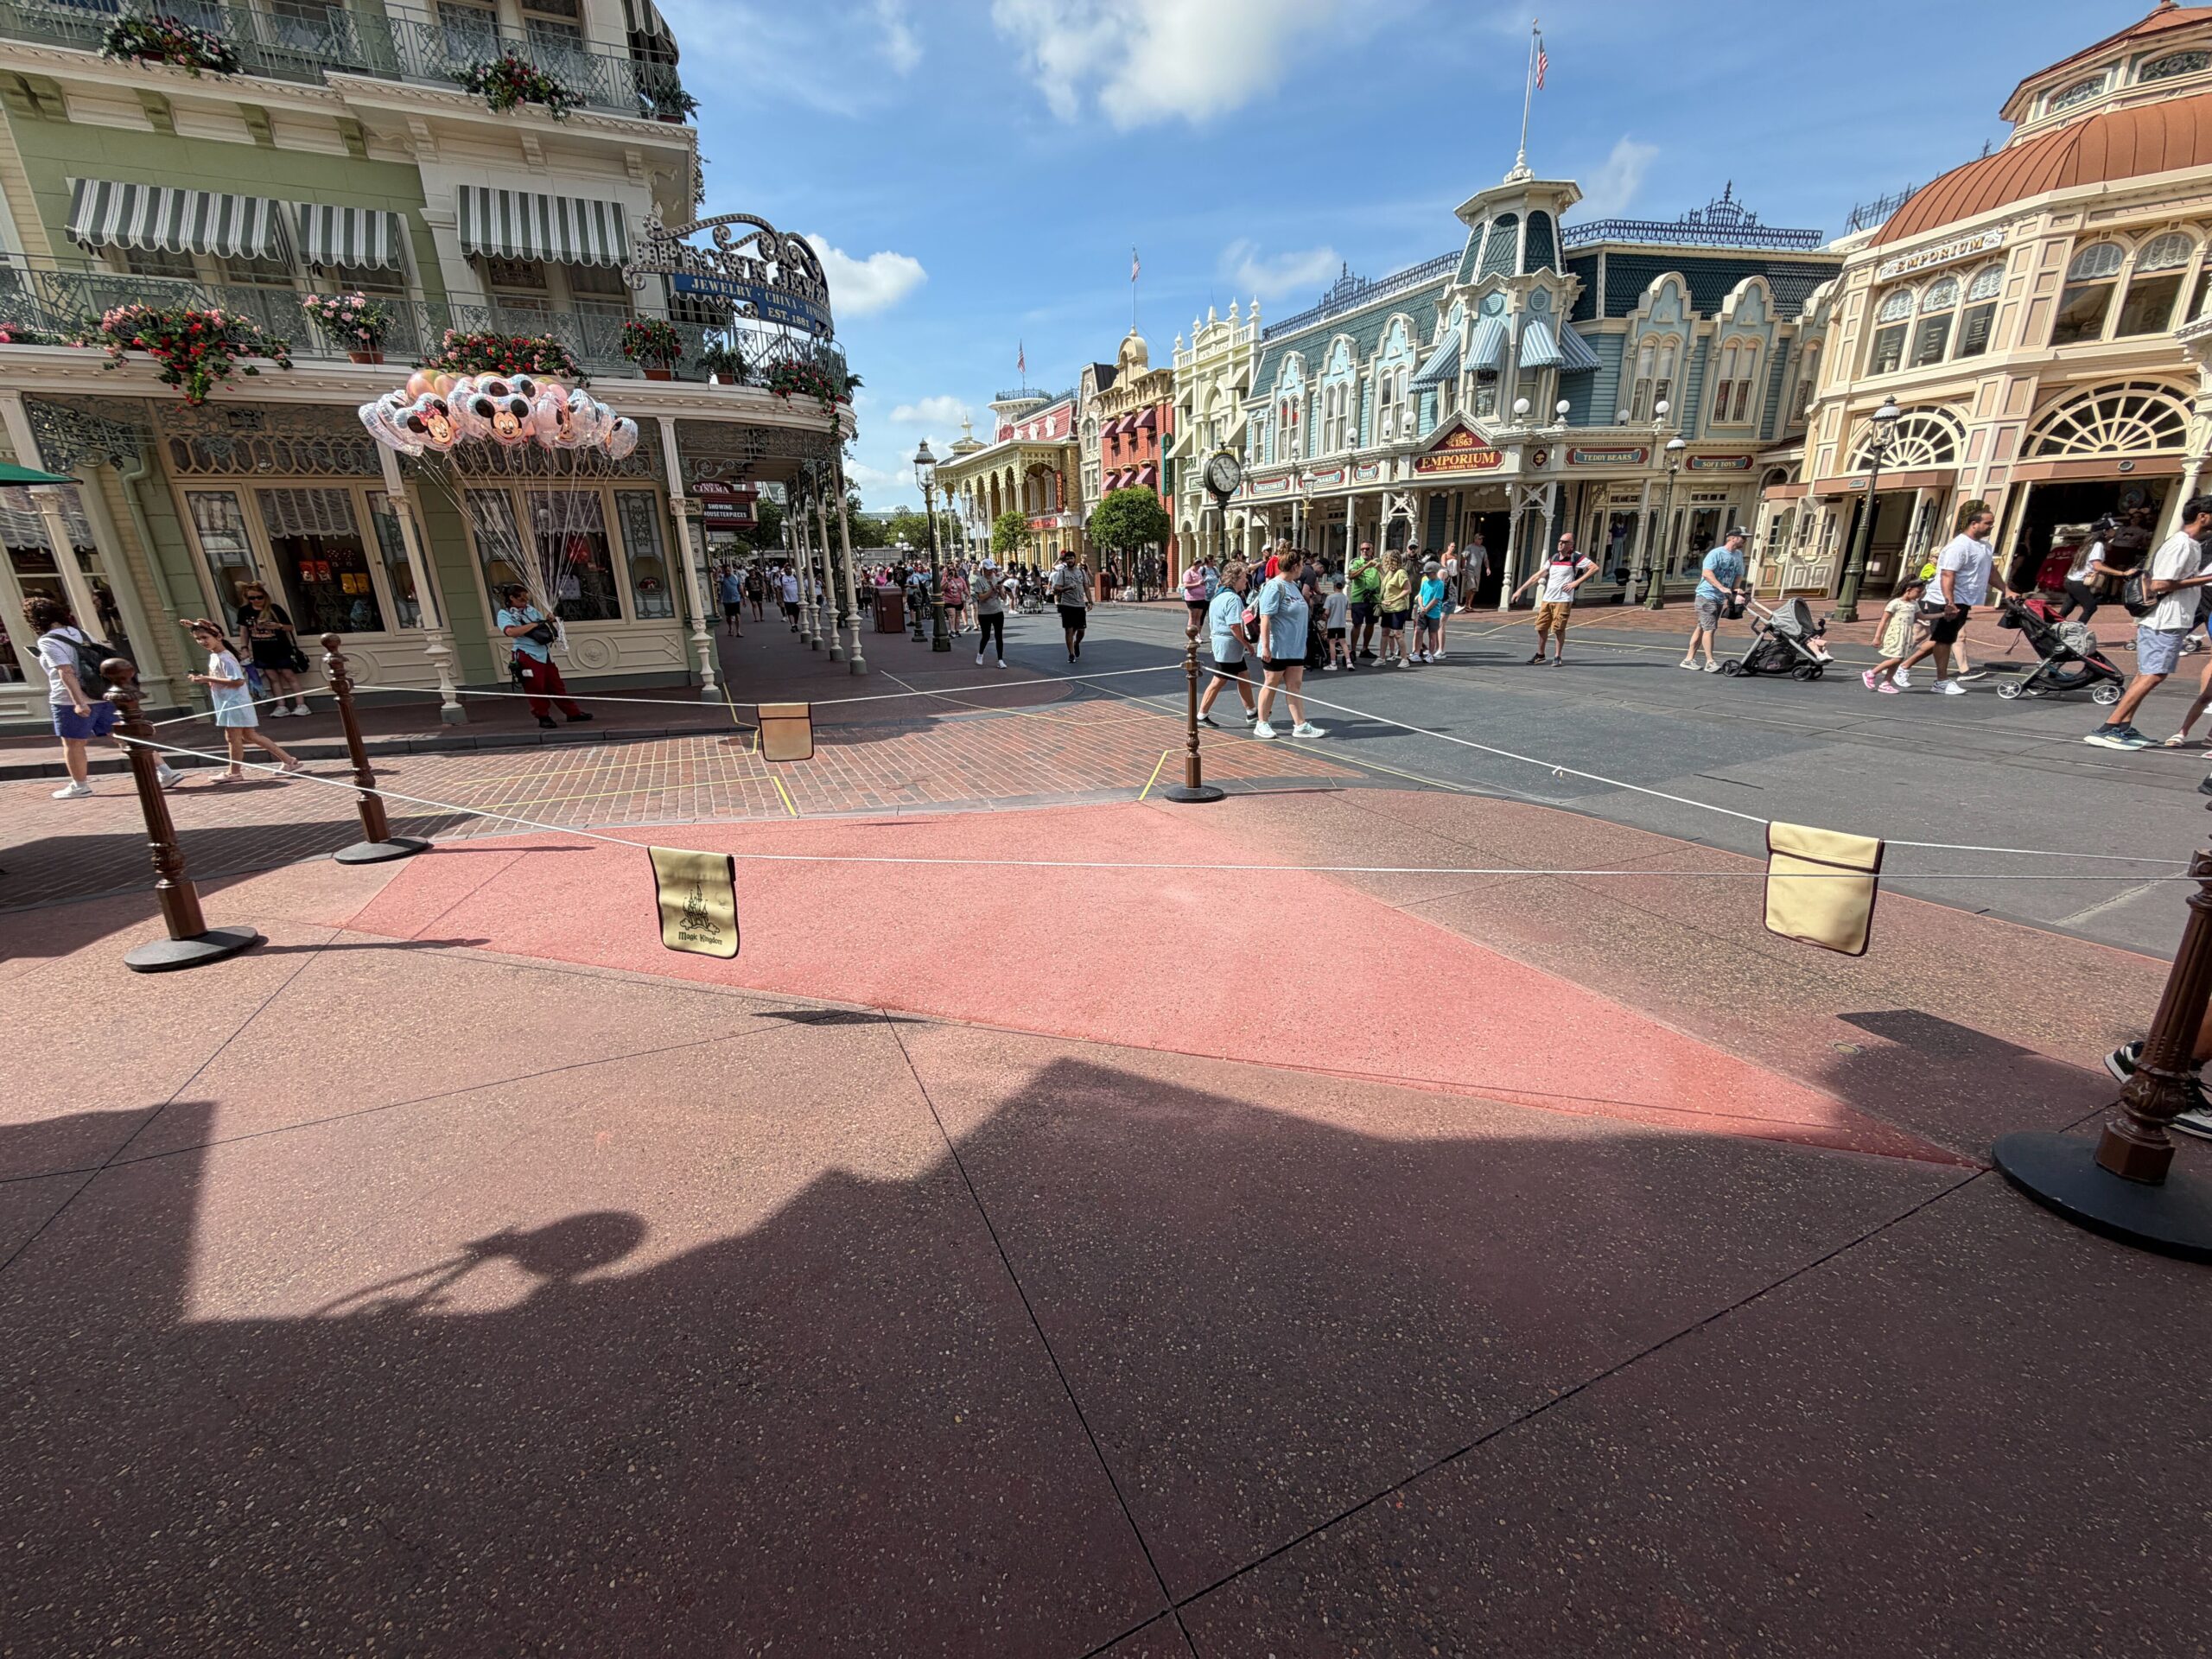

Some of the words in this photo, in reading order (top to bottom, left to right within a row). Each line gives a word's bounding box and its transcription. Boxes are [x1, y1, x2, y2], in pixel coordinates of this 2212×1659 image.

[632, 240, 768, 283] UPTOWN
[1896, 236, 1985, 272] EMPORIUM
[691, 277, 753, 297] JEWELRY
[765, 290, 797, 310] CHINA
[767, 306, 790, 321] EST.
[791, 315, 810, 327] 1881
[1455, 437, 1473, 448] 1863
[1421, 451, 1496, 469] EMPORIUM
[692, 484, 730, 494] CINEMA
[678, 931, 698, 941] Magic
[699, 933, 723, 945] Kingdom
